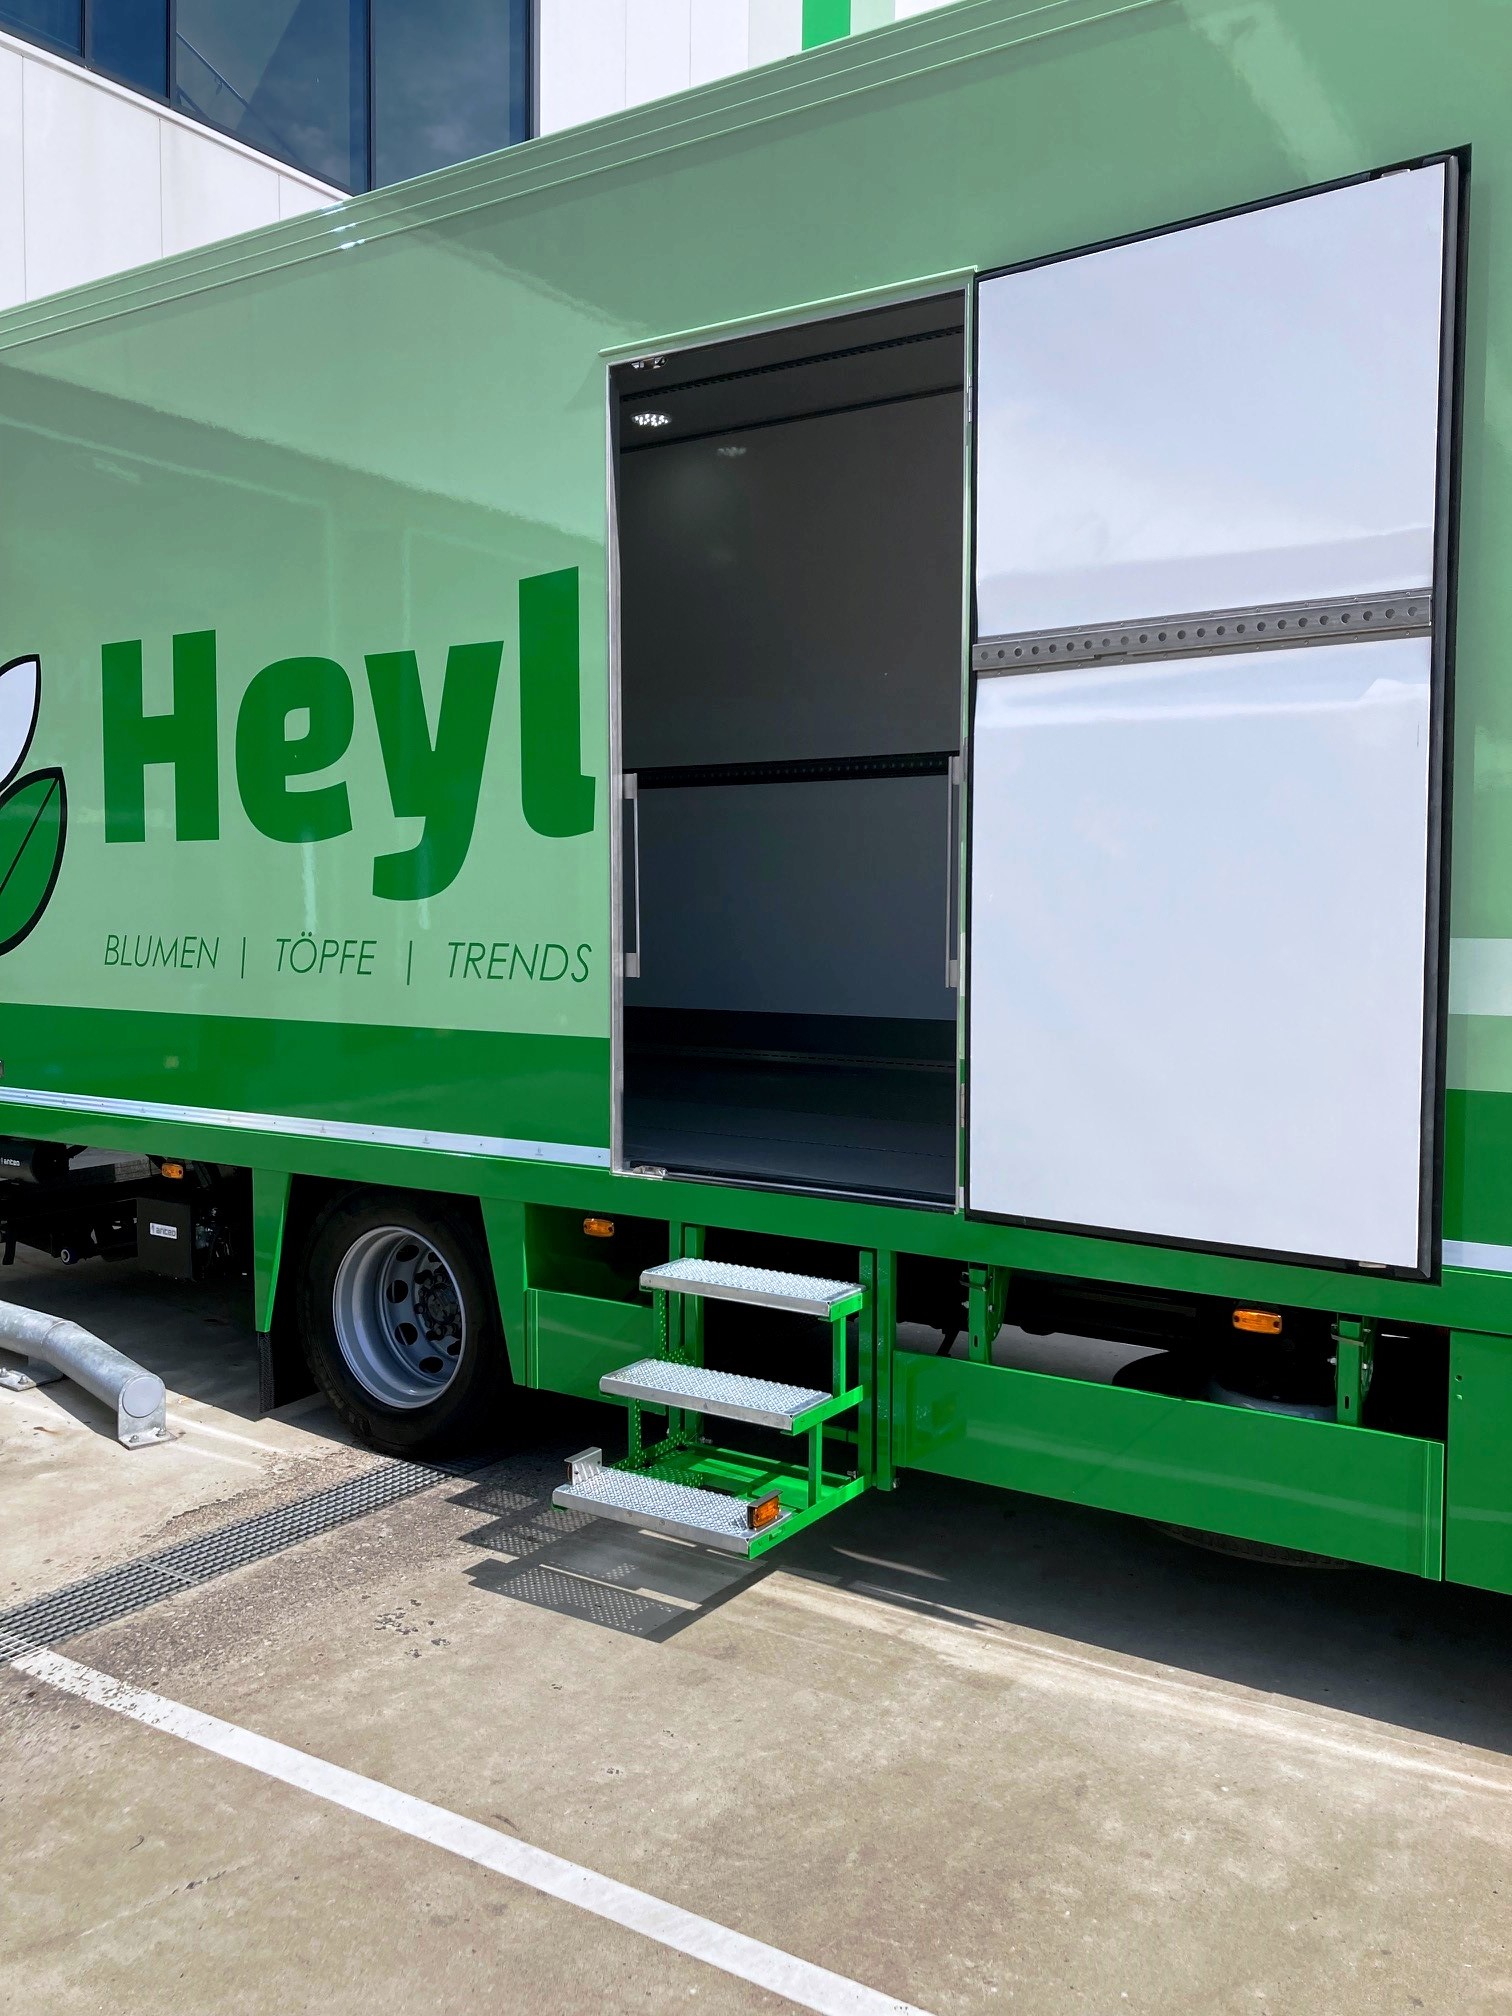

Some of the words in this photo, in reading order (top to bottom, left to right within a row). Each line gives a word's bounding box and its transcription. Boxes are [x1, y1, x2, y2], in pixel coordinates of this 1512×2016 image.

[102, 566, 596, 901] Heyl
[103, 934, 220, 969] BLUMEN
[276, 931, 378, 975] TÖPFE
[448, 942, 593, 983] TRENDS
